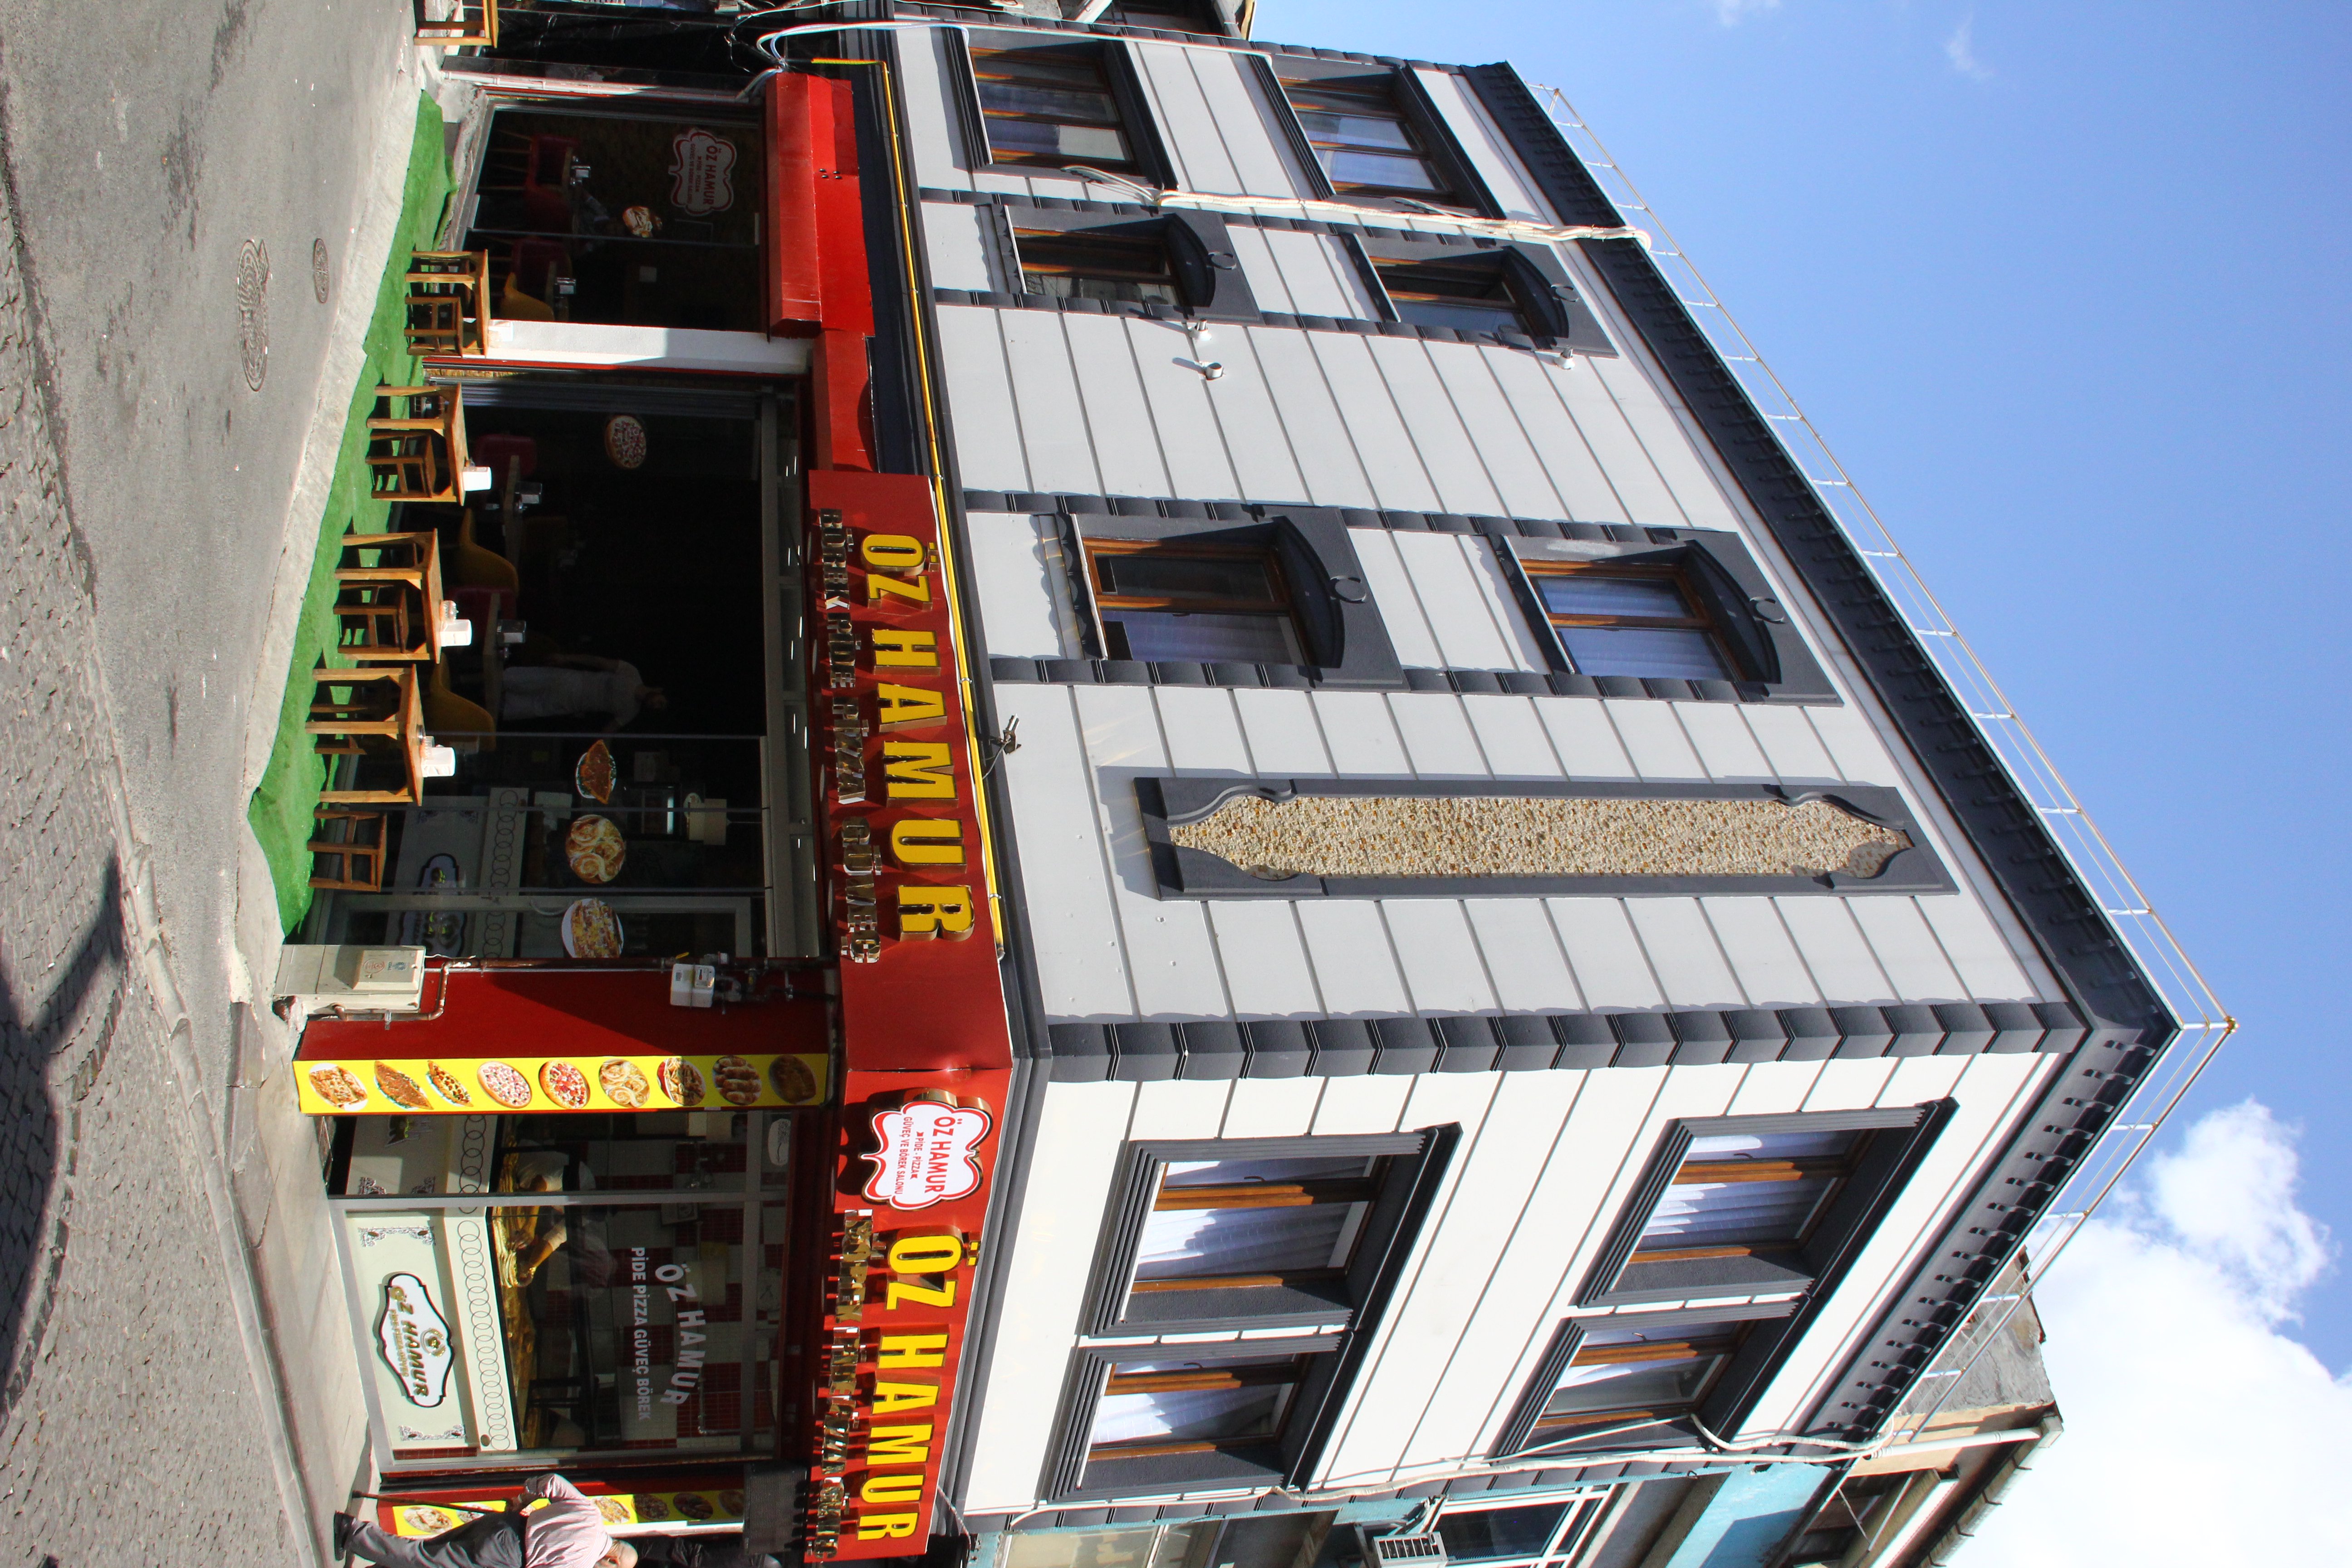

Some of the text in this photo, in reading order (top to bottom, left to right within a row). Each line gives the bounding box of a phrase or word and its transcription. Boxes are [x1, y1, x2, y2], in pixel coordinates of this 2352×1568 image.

[703, 146, 722, 205] ÖZ HAMUR
[819, 508, 882, 964] BÖREK PİDE PİZZA GÜVEÇ
[861, 534, 975, 941] ÖZ HAMUR
[897, 1149, 910, 1169] BÖREK
[899, 1117, 914, 1137] GÜVEÇ
[911, 1156, 922, 1173] PİZZA
[914, 1138, 925, 1151] PİDE
[925, 1117, 963, 1193] ÖZ HAMUR
[895, 1171, 905, 1194] SALONU
[389, 1286, 429, 1396] ÖZ HAMUR
[631, 1247, 653, 1421] PİDE PİZZA GÜVEÇ BÖREK
[655, 1264, 706, 1405] ÖZ HAMUR
[857, 1229, 980, 1540] ÖZ HAMUR
